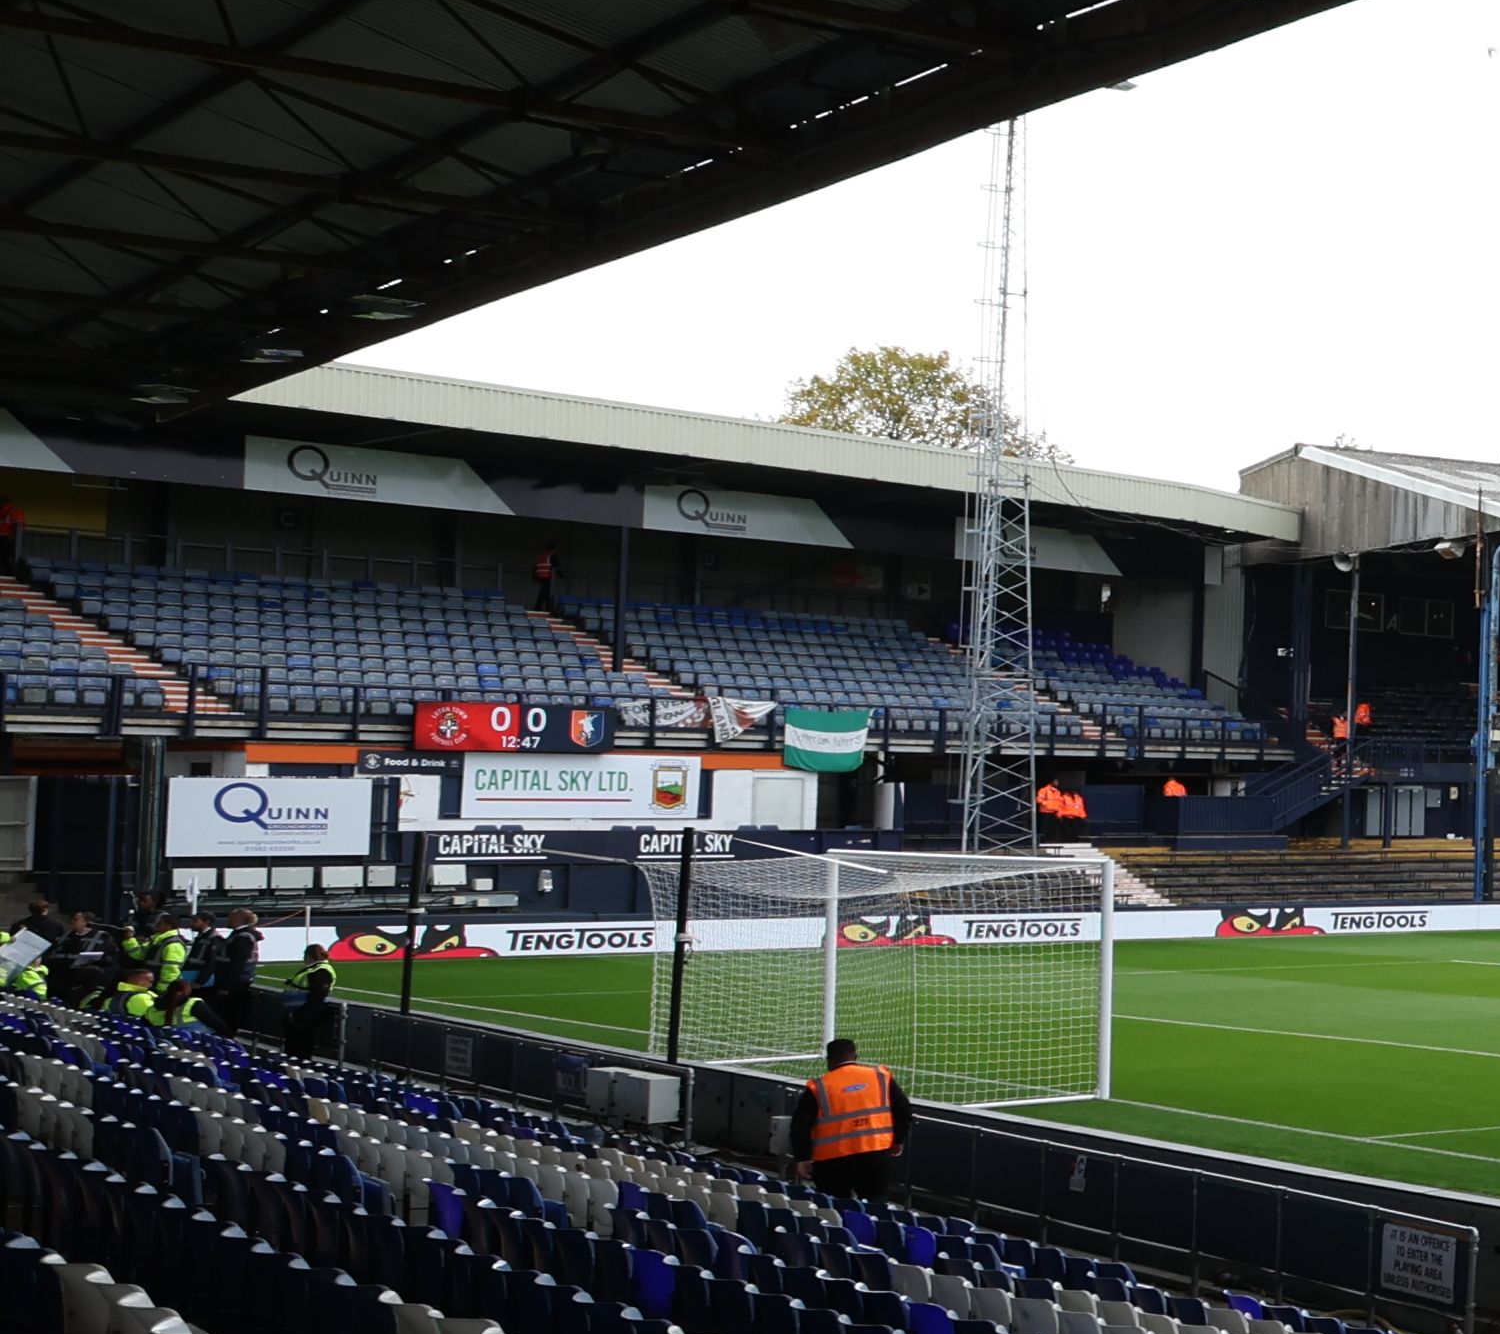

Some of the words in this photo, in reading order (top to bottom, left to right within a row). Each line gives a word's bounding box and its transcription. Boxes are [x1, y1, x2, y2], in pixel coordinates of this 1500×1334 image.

[287, 445, 377, 489] QUINN
[677, 489, 747, 527] QUINN
[490, 706, 511, 732] 0
[527, 707, 547, 733] 0
[501, 735, 541, 749] 12:47
[384, 757, 404, 767] Food
[411, 757, 419, 767] &
[421, 758, 446, 768] Drink
[475, 768, 553, 791] CAPITAL
[558, 770, 594, 792] SKY
[597, 771, 634, 792] LTD.
[214, 782, 329, 829] QUINN
[438, 834, 507, 855] CAPITAL
[512, 834, 545, 854] SKY
[640, 834, 701, 853] CAPITL
[705, 834, 732, 853] SKY
[964, 918, 1082, 938] TENGTOOLS
[1331, 910, 1429, 929] TENGTOOLS
[507, 927, 654, 951] TENGTOOLS
[1391, 1229, 1399, 1240] IT
[1408, 1233, 1419, 1245] AN
[1421, 1235, 1450, 1252] OFFENCE
[1396, 1245, 1405, 1257] TO
[1407, 1248, 1429, 1262] ENTER
[1431, 1253, 1443, 1266] THE
[1394, 1259, 1422, 1276] PLAYING
[1424, 1267, 1442, 1282] AREA
[1383, 1272, 1408, 1289] UNLESS
[1411, 1279, 1451, 1299] AUTHORISED
